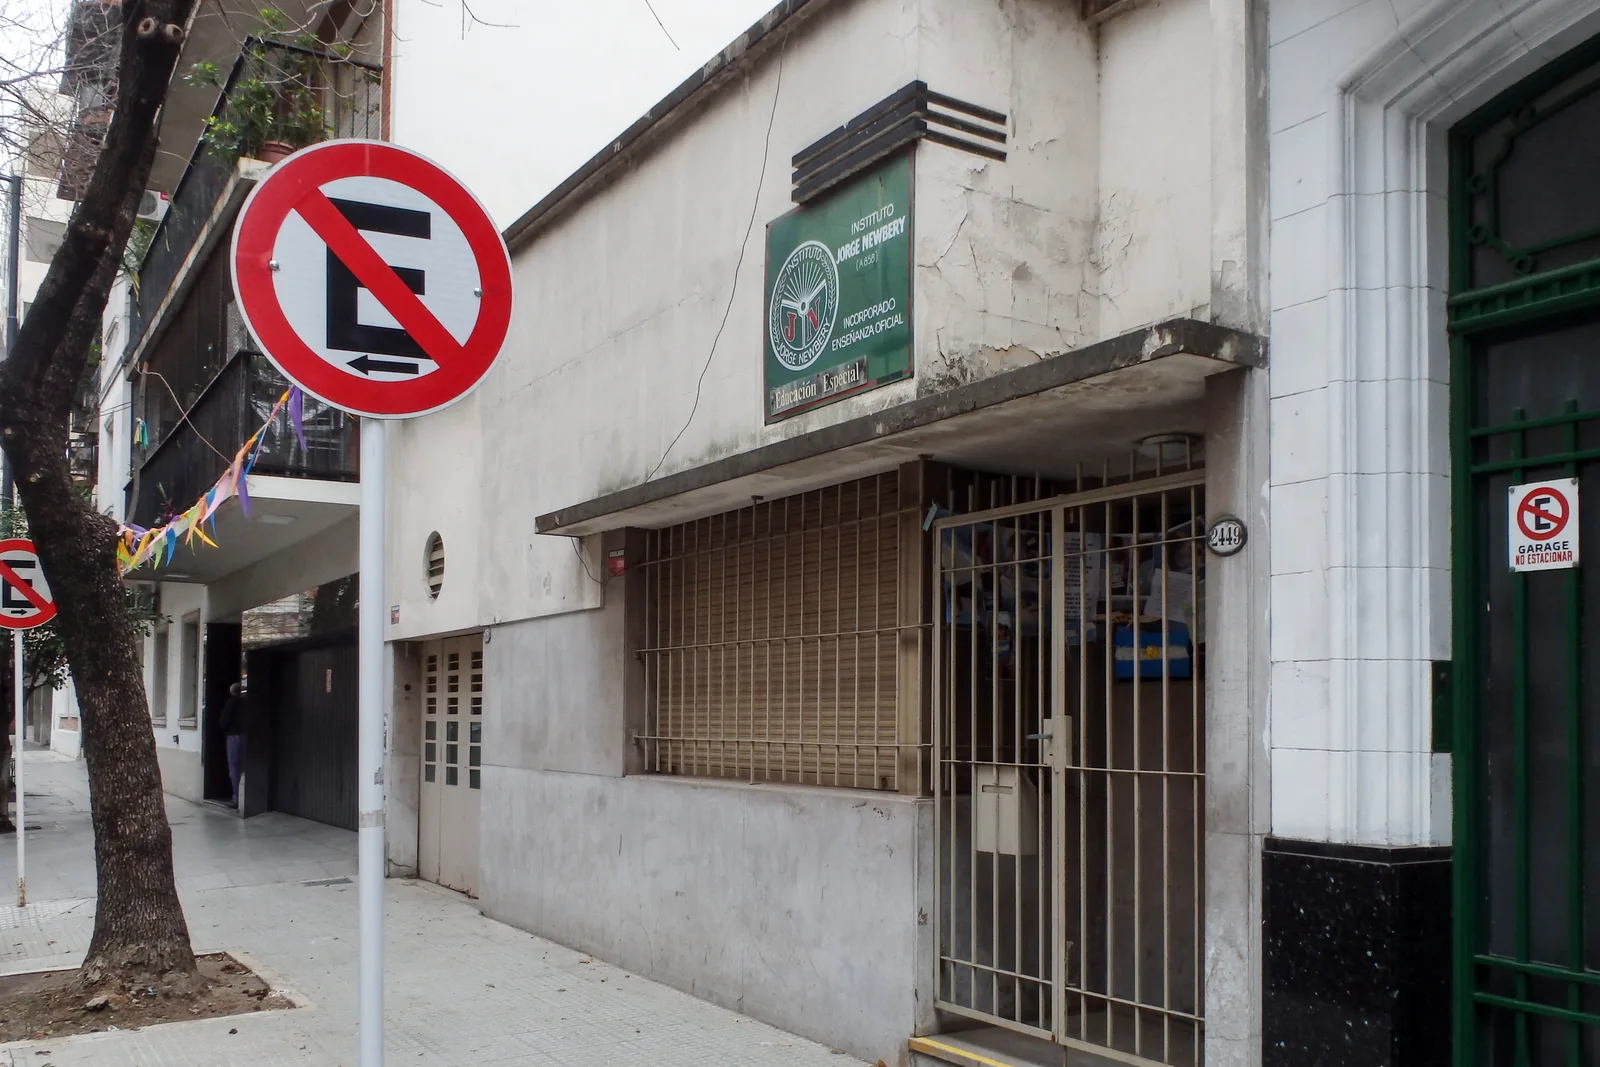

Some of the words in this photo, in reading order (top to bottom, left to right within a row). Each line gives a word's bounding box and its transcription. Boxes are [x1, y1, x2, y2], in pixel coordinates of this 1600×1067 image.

[851, 203, 894, 235] INSTITUTO
[836, 240, 860, 264] JORGE
[862, 216, 906, 251] NEWBERY
[785, 246, 822, 275] INSTITUTO
[326, 196, 433, 361] E
[843, 297, 896, 329] INCORPORADO
[777, 342, 797, 365] JORGE
[798, 317, 831, 365] NEWBERY
[831, 324, 875, 351] ENSEÑANZA
[874, 313, 904, 333] OFICIAL
[775, 381, 817, 409] Educación
[823, 362, 860, 393] Especial
[1534, 497, 1551, 530] E
[1210, 526, 1240, 547] 2449
[1518, 540, 1569, 554] GARAGE
[1515, 554, 1525, 565] NO
[1527, 550, 1573, 565] ESTACIONAR
[2, 560, 36, 608] E
